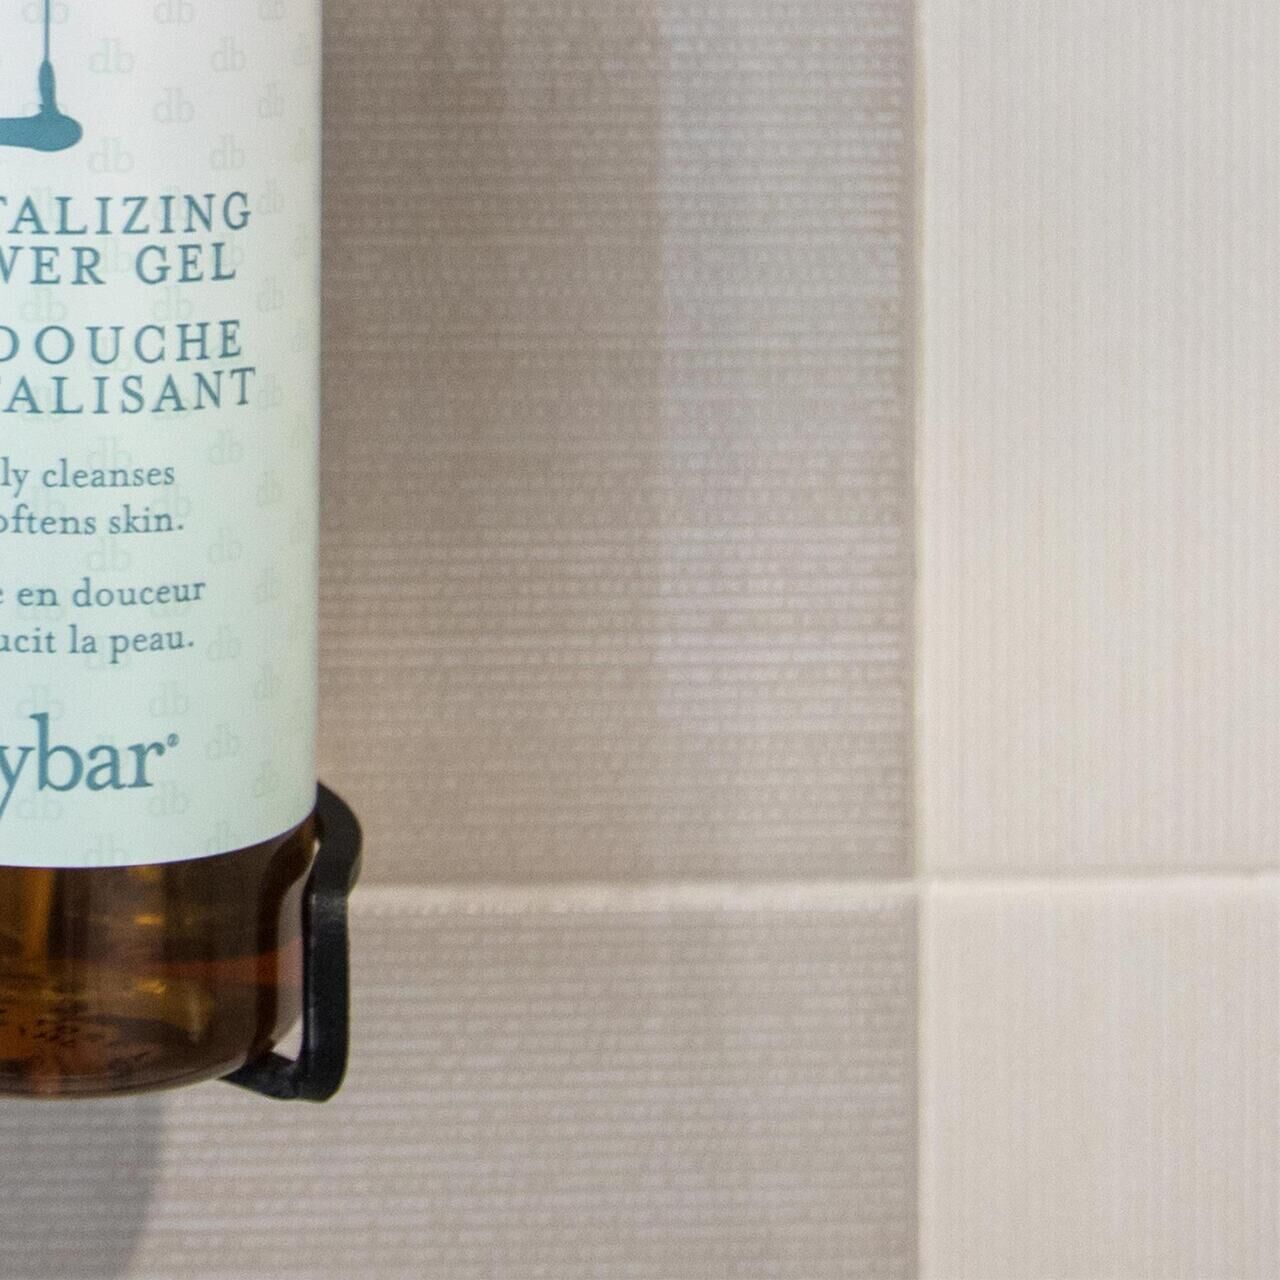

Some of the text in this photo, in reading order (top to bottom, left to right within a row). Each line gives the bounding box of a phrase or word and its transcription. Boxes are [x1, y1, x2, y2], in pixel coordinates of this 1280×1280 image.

[134, 241, 236, 286] GEL
[41, 457, 176, 489] cleanses
[108, 503, 184, 535] skin.
[16, 587, 60, 607] en
[71, 579, 207, 608] douceur
[68, 623, 98, 655] la
[108, 630, 195, 666] peau.
